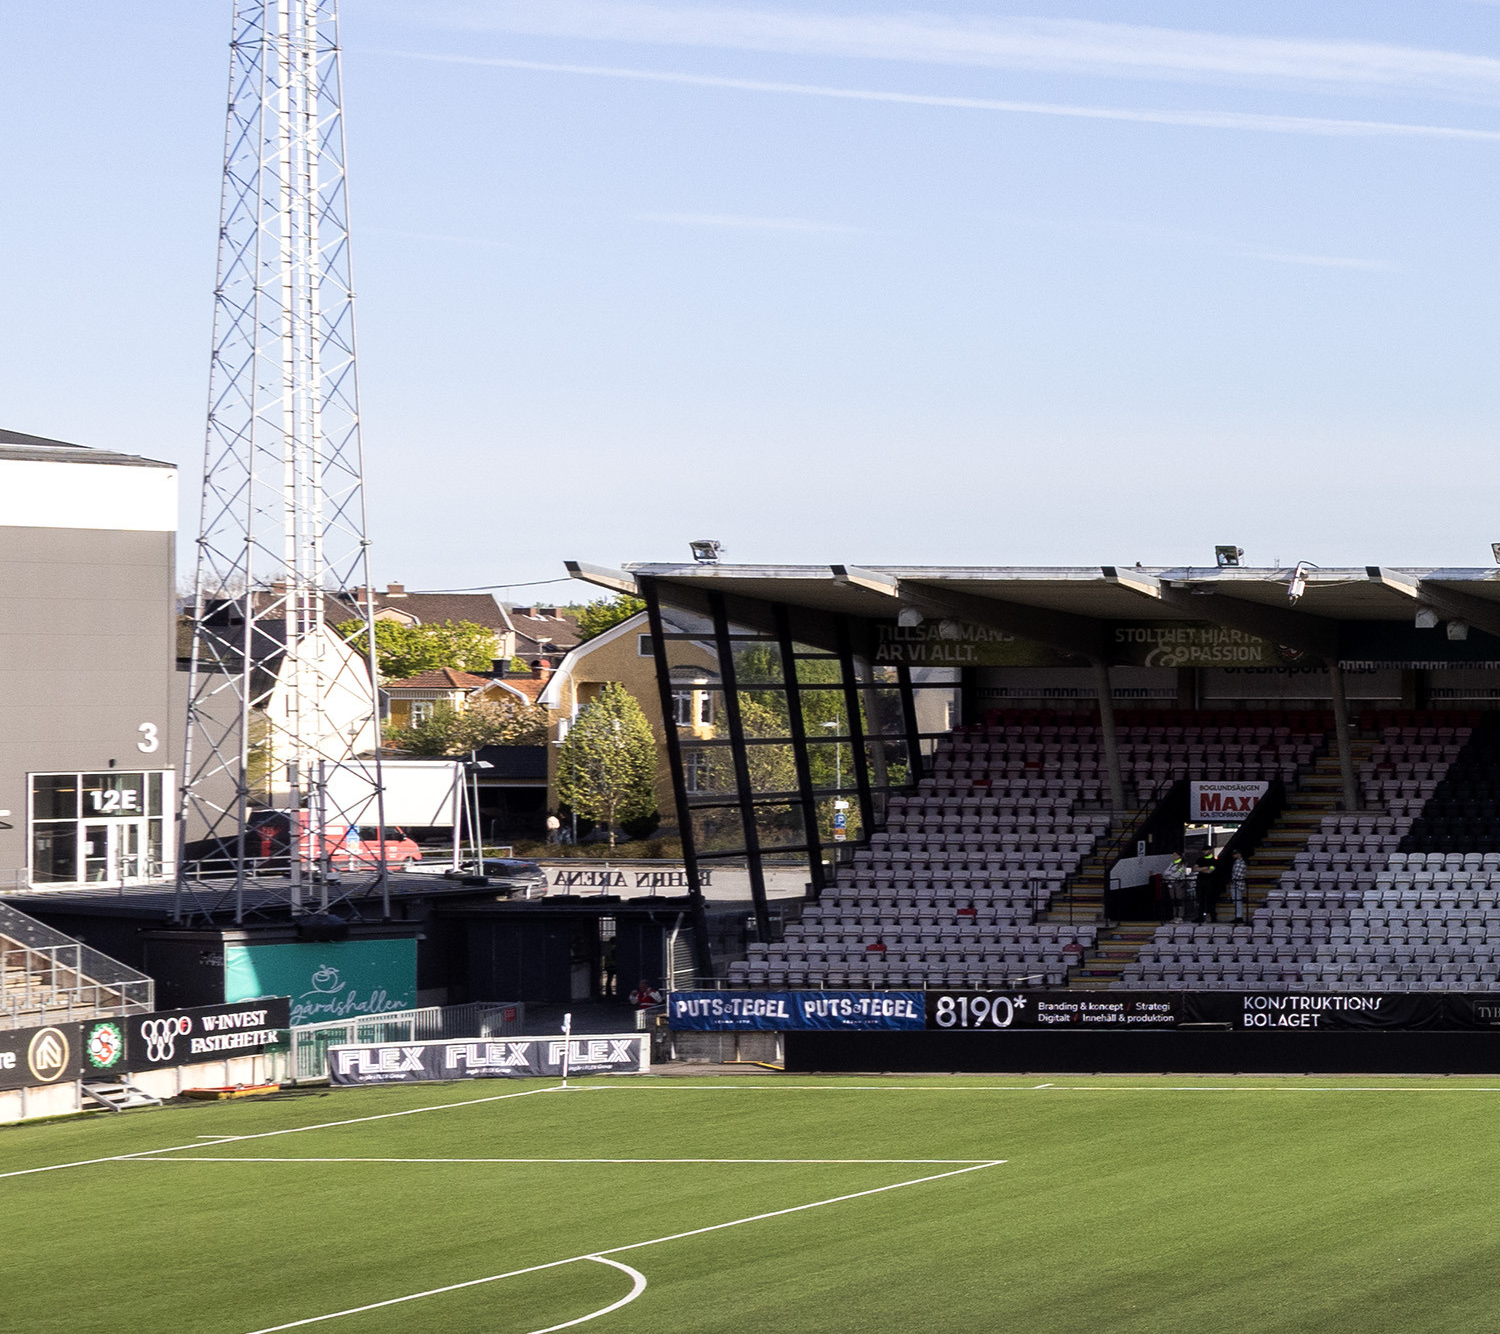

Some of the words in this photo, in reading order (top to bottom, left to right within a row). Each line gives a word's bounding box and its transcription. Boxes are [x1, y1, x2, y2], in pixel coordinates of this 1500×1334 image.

[907, 644, 926, 660] VI
[930, 645, 978, 660] ALLT.
[1191, 646, 1262, 661] PASSION
[137, 722, 159, 753] 3
[90, 789, 137, 811] 12E
[290, 990, 407, 1026] gårdshallen
[1038, 1002, 1078, 1012] Branding
[1080, 1002, 1087, 1011] &
[1089, 1002, 1124, 1012] koncept
[1135, 1002, 1170, 1012] Strategi
[1244, 996, 1382, 1011] KONSTRUKTIONS
[202, 1010, 267, 1032] W-INVEST
[1038, 1013, 1070, 1023] Digitalt
[1082, 1012, 1117, 1022] Innehåll
[1127, 1013, 1174, 1023] produktion
[1244, 1013, 1321, 1027] BOLAGET
[191, 1030, 278, 1054] FASTIGHETER
[549, 1040, 631, 1065] FLEX
[338, 1046, 425, 1074] FLEX
[446, 1043, 530, 1069] FLEX
